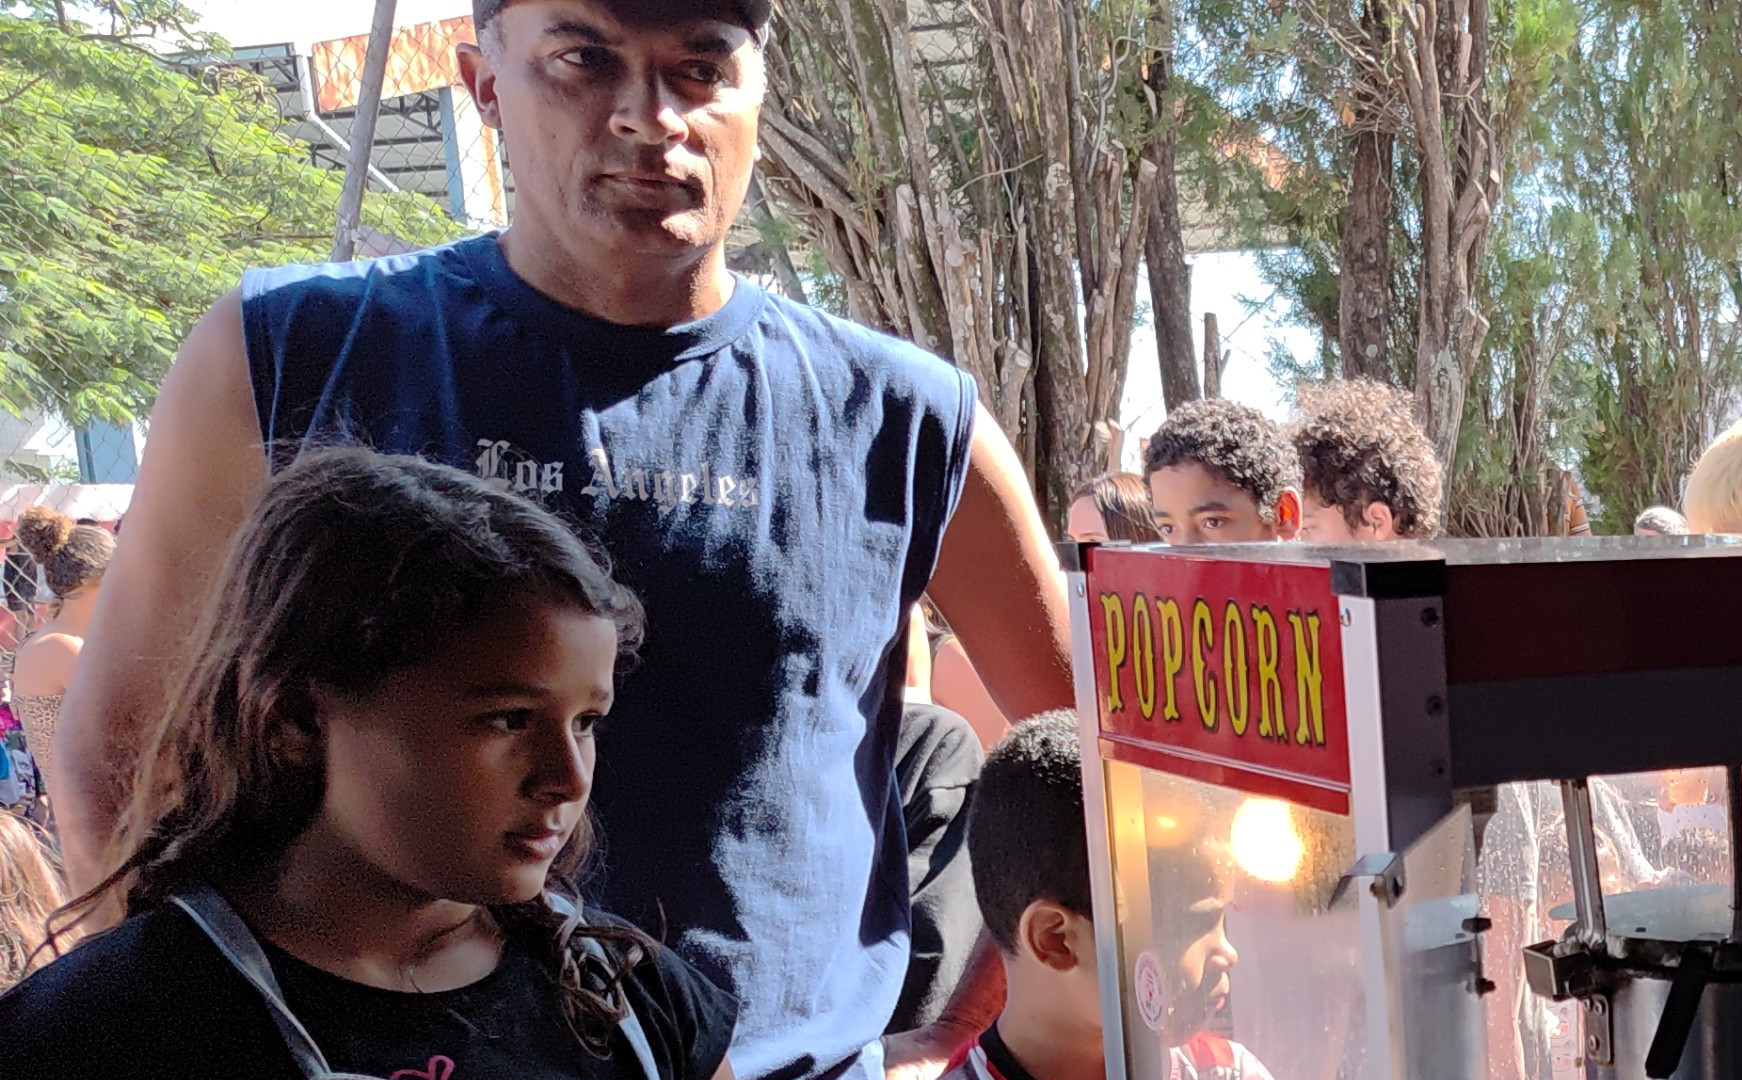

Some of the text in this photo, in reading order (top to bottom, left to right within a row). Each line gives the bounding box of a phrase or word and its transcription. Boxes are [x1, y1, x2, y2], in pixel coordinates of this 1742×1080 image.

[475, 438, 760, 512] Los Angeles
[1101, 592, 1326, 746] POPCORN
